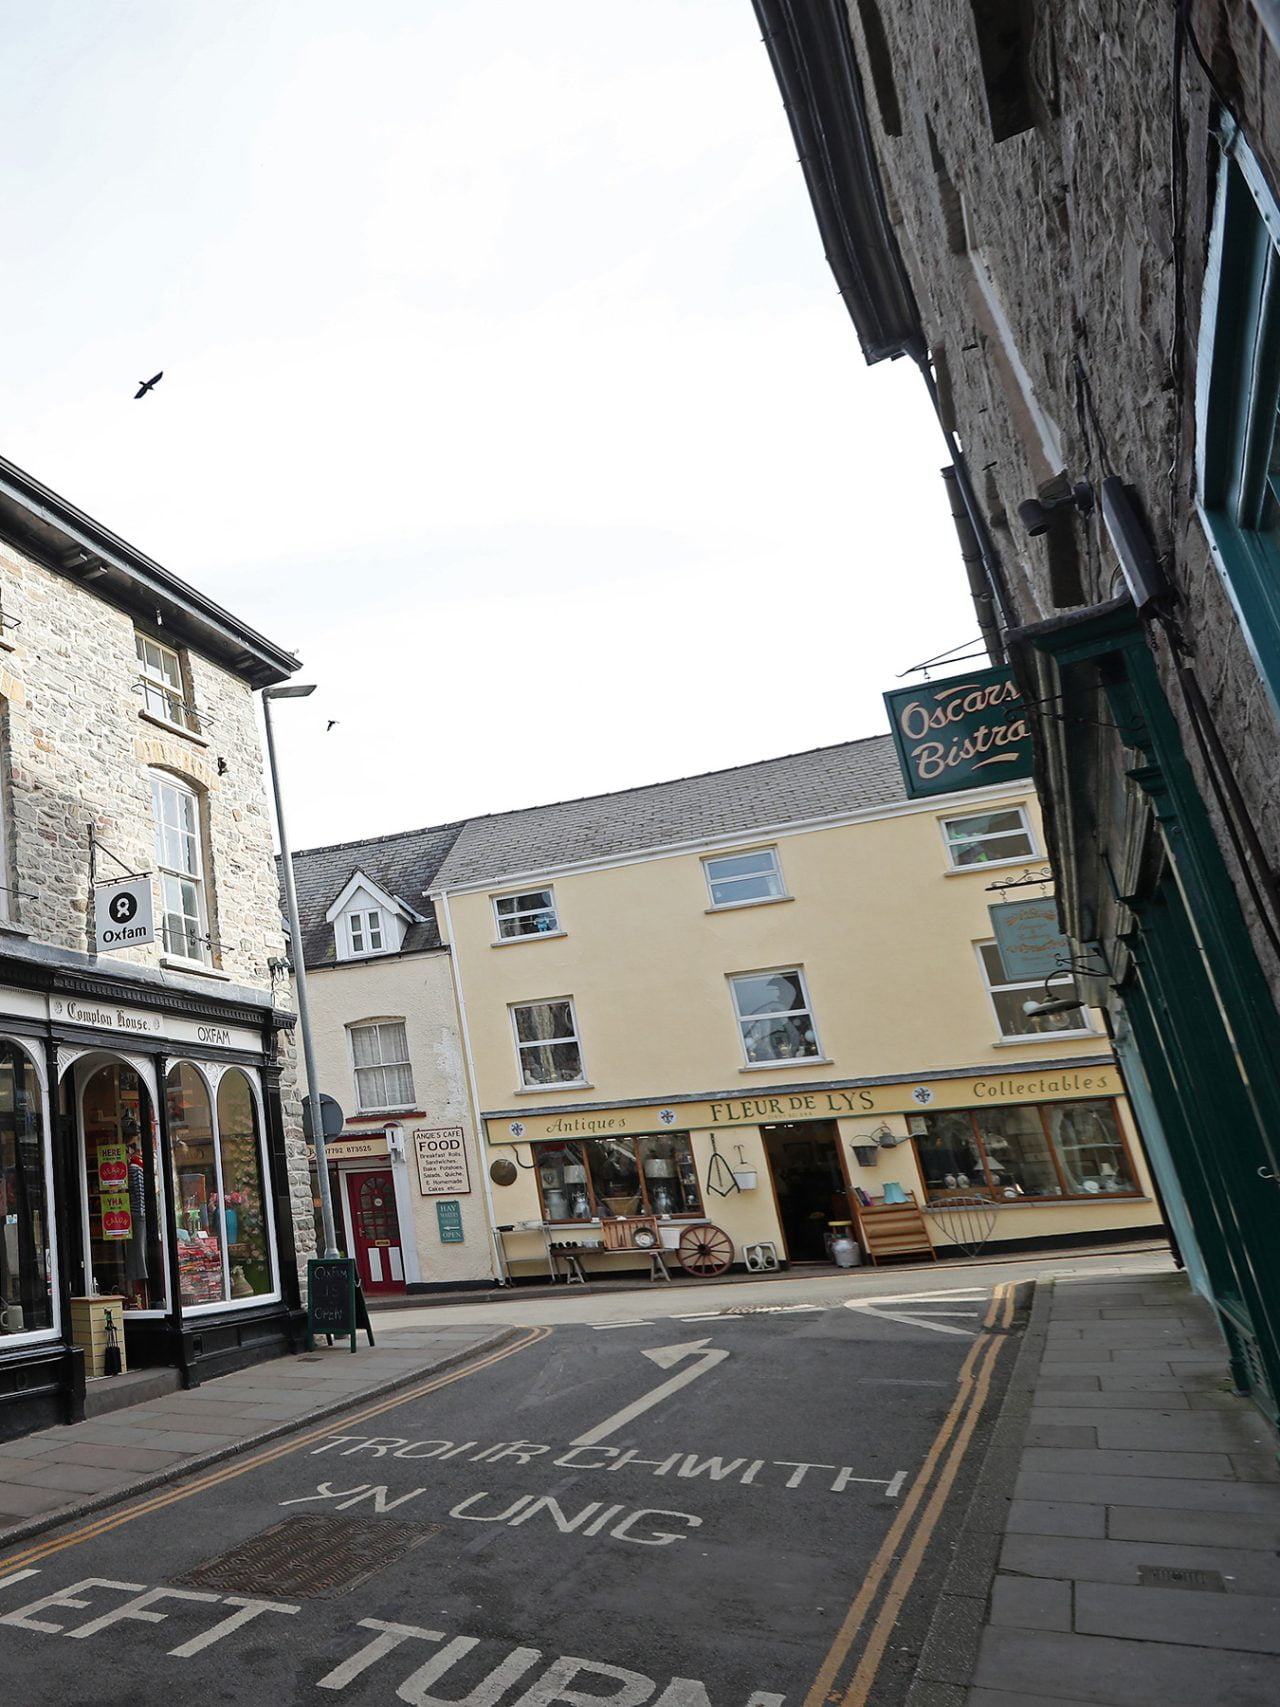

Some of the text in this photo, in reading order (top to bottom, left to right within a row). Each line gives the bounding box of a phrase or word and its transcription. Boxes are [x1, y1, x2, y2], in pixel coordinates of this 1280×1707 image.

[901, 680, 1022, 740] Oscars
[911, 719, 1032, 780] Bistro
[103, 926, 147, 943] Oxfam
[67, 1000, 113, 1028] Compton
[197, 1025, 231, 1046] OXFAM
[973, 1074, 1108, 1098] Collectables
[711, 1090, 875, 1122] FLEUR DE LYS
[546, 1116, 628, 1134] Antiques
[346, 1145, 371, 1153] 873525
[419, 1139, 460, 1151] FOOD
[440, 1204, 457, 1212] HAY
[443, 1231, 461, 1239] OPEN
[553, 1446, 909, 1498] CHWITH
[278, 1482, 703, 1546] YN UNIG
